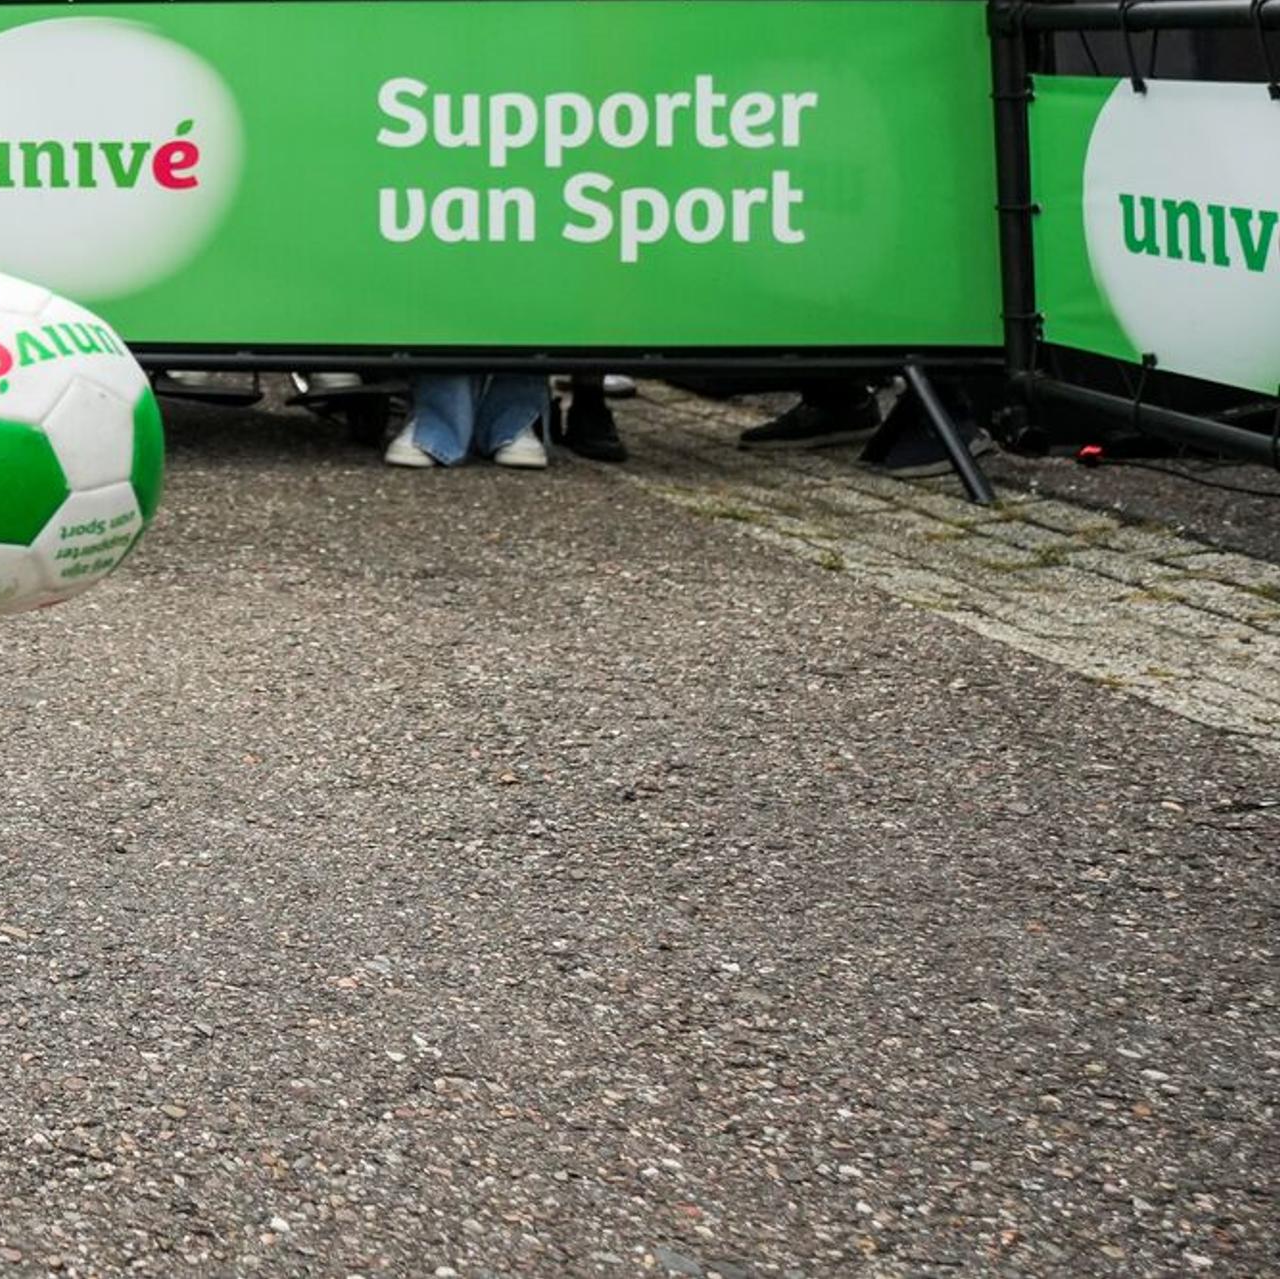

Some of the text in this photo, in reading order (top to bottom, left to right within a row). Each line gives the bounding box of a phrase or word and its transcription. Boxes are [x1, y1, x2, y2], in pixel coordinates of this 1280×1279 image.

[376, 74, 819, 168] Supporter
[377, 169, 807, 264] van Sport
[1118, 193, 1280, 273] univ
